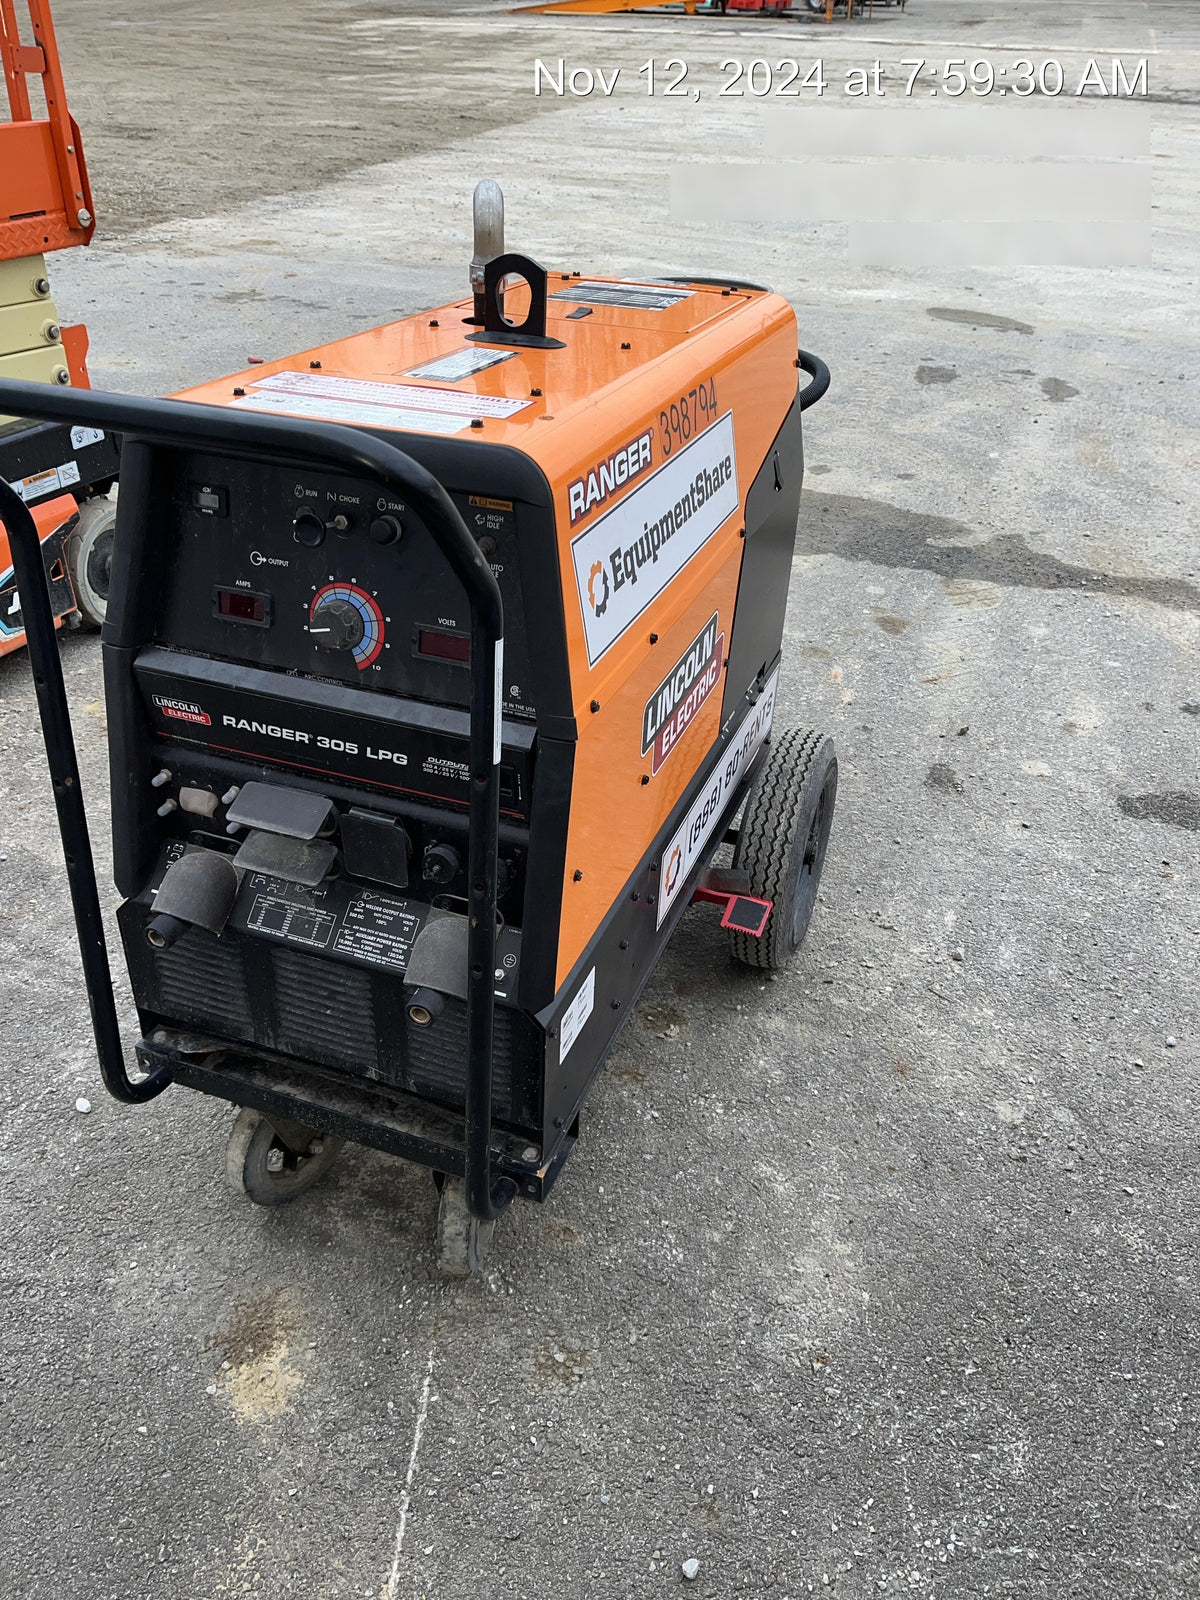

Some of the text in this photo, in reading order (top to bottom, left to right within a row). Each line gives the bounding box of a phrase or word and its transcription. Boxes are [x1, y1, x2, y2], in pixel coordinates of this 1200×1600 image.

[659, 376, 718, 456] 398794
[304, 489, 318, 498] RUN
[338, 494, 360, 505] CHOKE
[387, 502, 405, 511] START
[486, 513, 505, 524] HIGH
[609, 454, 732, 592] EquipmentShare
[486, 521, 501, 530] IDLE
[267, 557, 289, 567] OUTPUT
[489, 563, 504, 572] UTO
[235, 579, 251, 588] AMPS
[437, 616, 456, 627] VOLTS
[645, 623, 715, 743] LINCOLN
[155, 696, 199, 714] LINCOLN
[515, 703, 525, 711] THE
[661, 658, 718, 757] ELECTRIC
[168, 708, 207, 724] ELECTRIC
[316, 736, 359, 755] 305
[366, 746, 408, 766] LPG
[688, 694, 774, 854] (888) 80-RENTS
[366, 904, 382, 912] WELDER
[383, 907, 399, 916] OUTPUT
[377, 937, 391, 945] POWER
